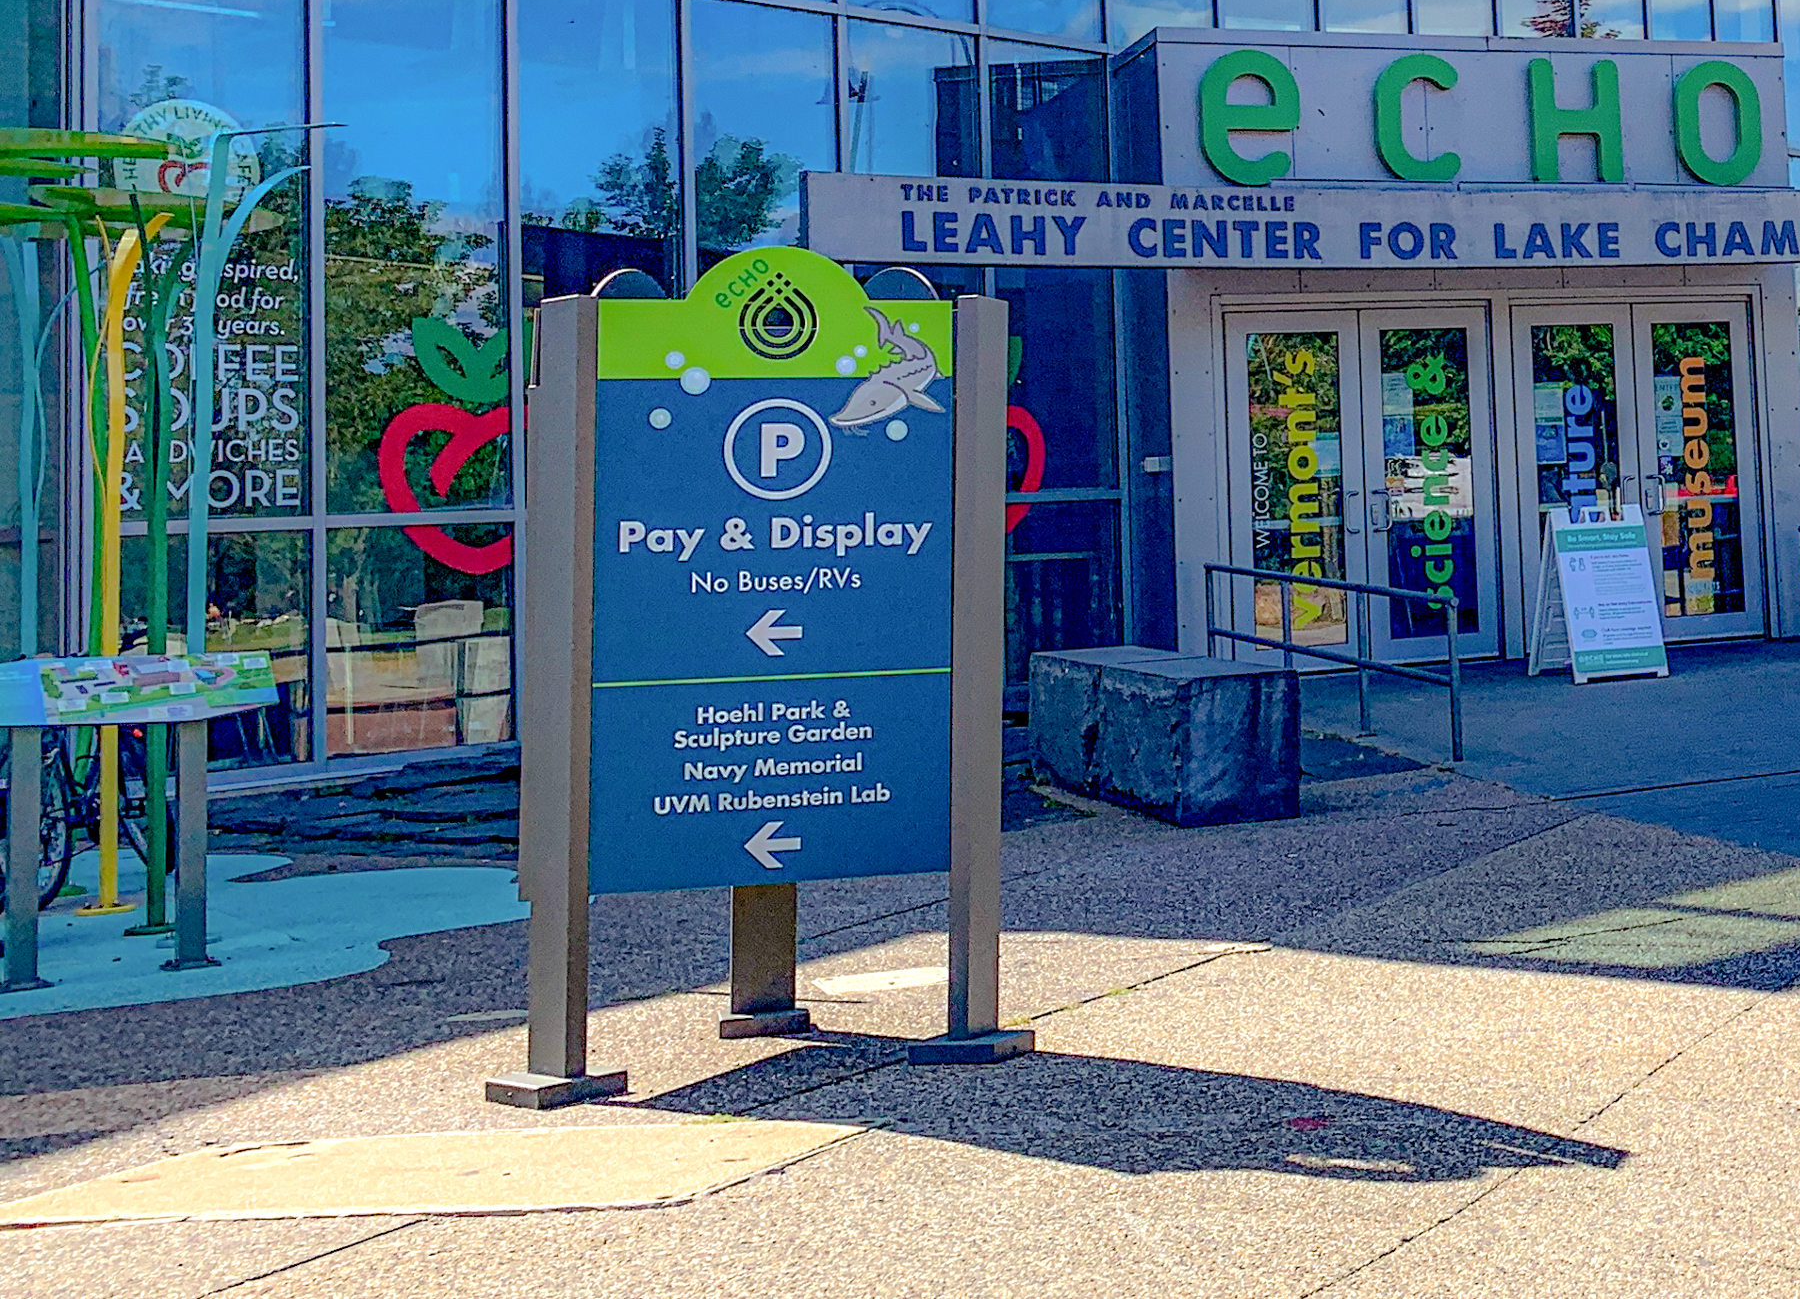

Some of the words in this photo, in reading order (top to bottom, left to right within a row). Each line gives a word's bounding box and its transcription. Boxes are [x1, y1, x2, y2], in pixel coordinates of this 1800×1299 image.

[901, 183, 949, 203] THE
[969, 186, 1077, 207] PATRICK
[1097, 190, 1151, 210] AND
[1170, 193, 1296, 212] MARCELLE
[901, 209, 1087, 256] LEAHY
[1127, 217, 1323, 261] CENTER
[1358, 221, 1458, 261] FOR
[1494, 222, 1621, 260] LAKE
[248, 287, 285, 314] for
[122, 315, 176, 333] ovr
[217, 318, 286, 340] years.
[1406, 351, 1446, 395] &
[760, 422, 806, 478] P
[1252, 433, 1268, 459] TO
[1561, 384, 1599, 523] ature
[1679, 356, 1716, 580] museum
[1253, 461, 1271, 549] WELCOME
[1272, 350, 1323, 631] vermont's
[1410, 414, 1455, 610] science
[618, 520, 706, 562] Pay
[719, 517, 755, 550] &
[770, 512, 933, 557] Display
[690, 571, 729, 594] No
[738, 567, 862, 594] Buses/RVs
[697, 702, 764, 725] Hoehl
[771, 700, 826, 721] Park
[832, 700, 851, 719] &
[674, 727, 782, 751] Sculpture
[787, 721, 874, 744] Garden
[683, 762, 748, 783] Navy
[754, 752, 863, 777] Memorial
[653, 794, 712, 815] UVM
[717, 786, 844, 812] Rubenstein
[850, 783, 892, 804] Lab
